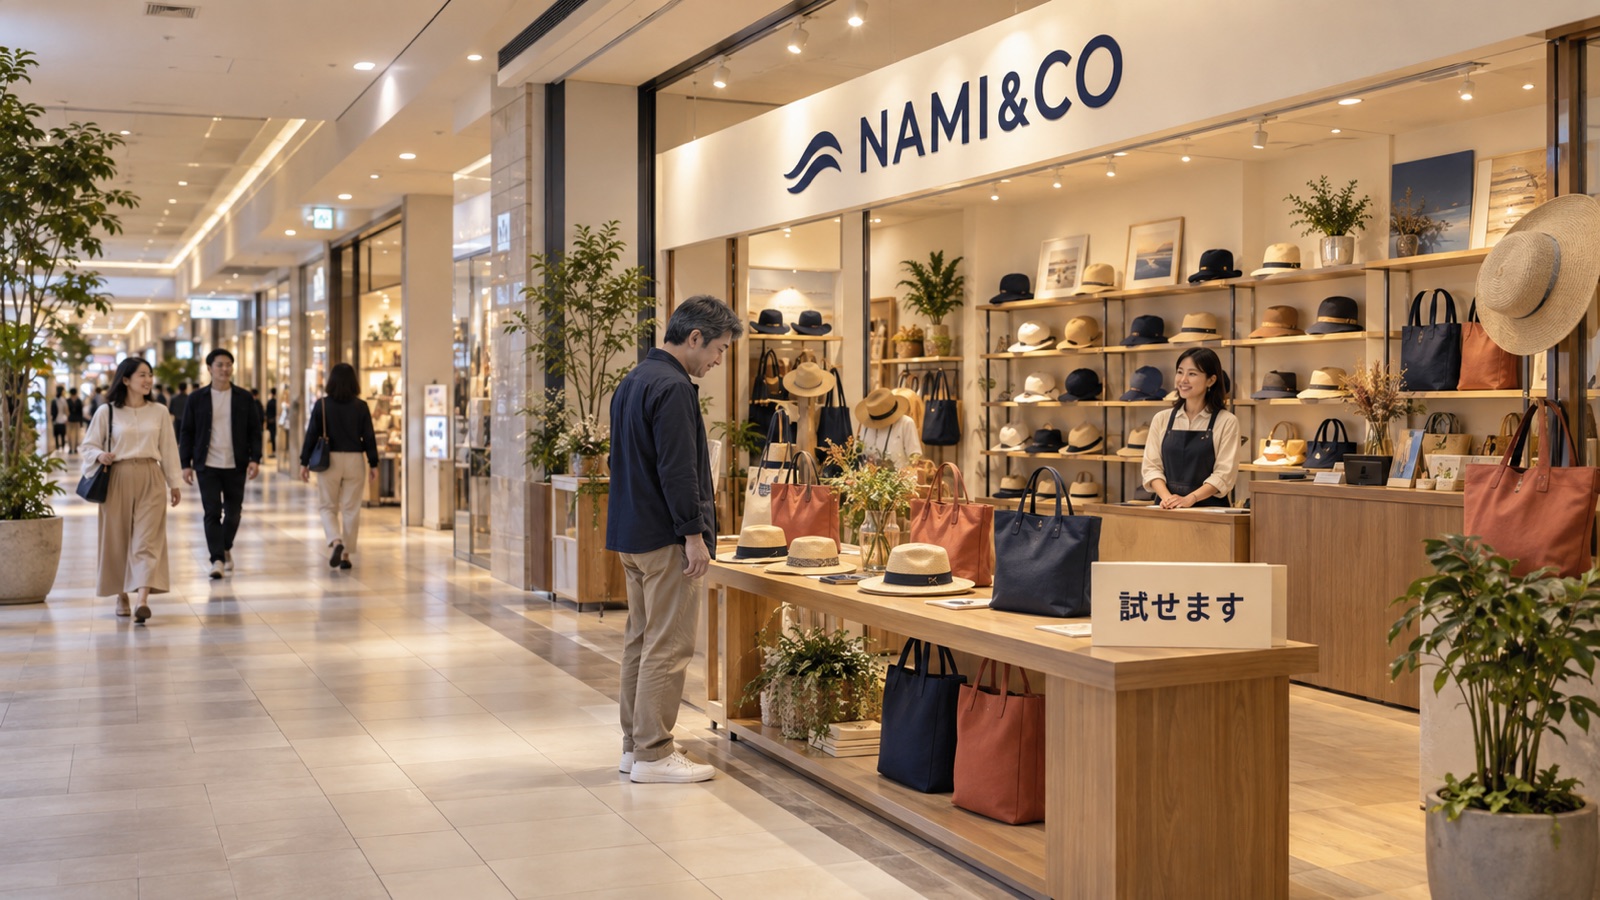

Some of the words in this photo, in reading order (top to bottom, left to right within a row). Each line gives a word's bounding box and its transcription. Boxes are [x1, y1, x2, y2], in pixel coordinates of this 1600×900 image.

[860, 34, 1124, 173] NAMI&CO
[1119, 591, 1244, 623] 試せます
